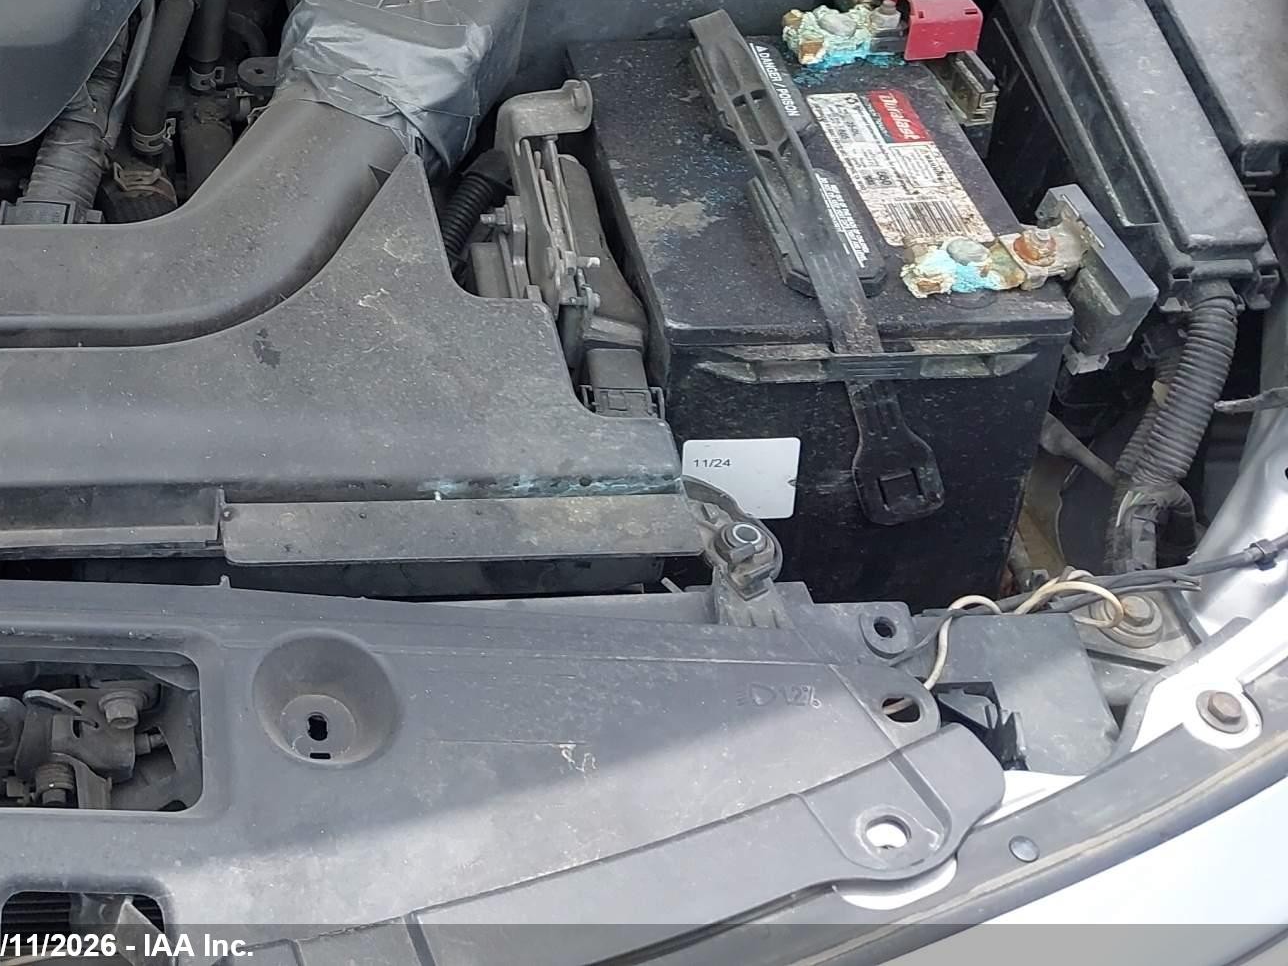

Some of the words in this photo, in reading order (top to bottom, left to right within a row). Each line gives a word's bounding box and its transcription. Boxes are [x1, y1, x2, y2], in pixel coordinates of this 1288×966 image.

[758, 52, 782, 83] DANGER
[775, 88, 801, 117] POISON
[693, 458, 732, 468] 11/24
